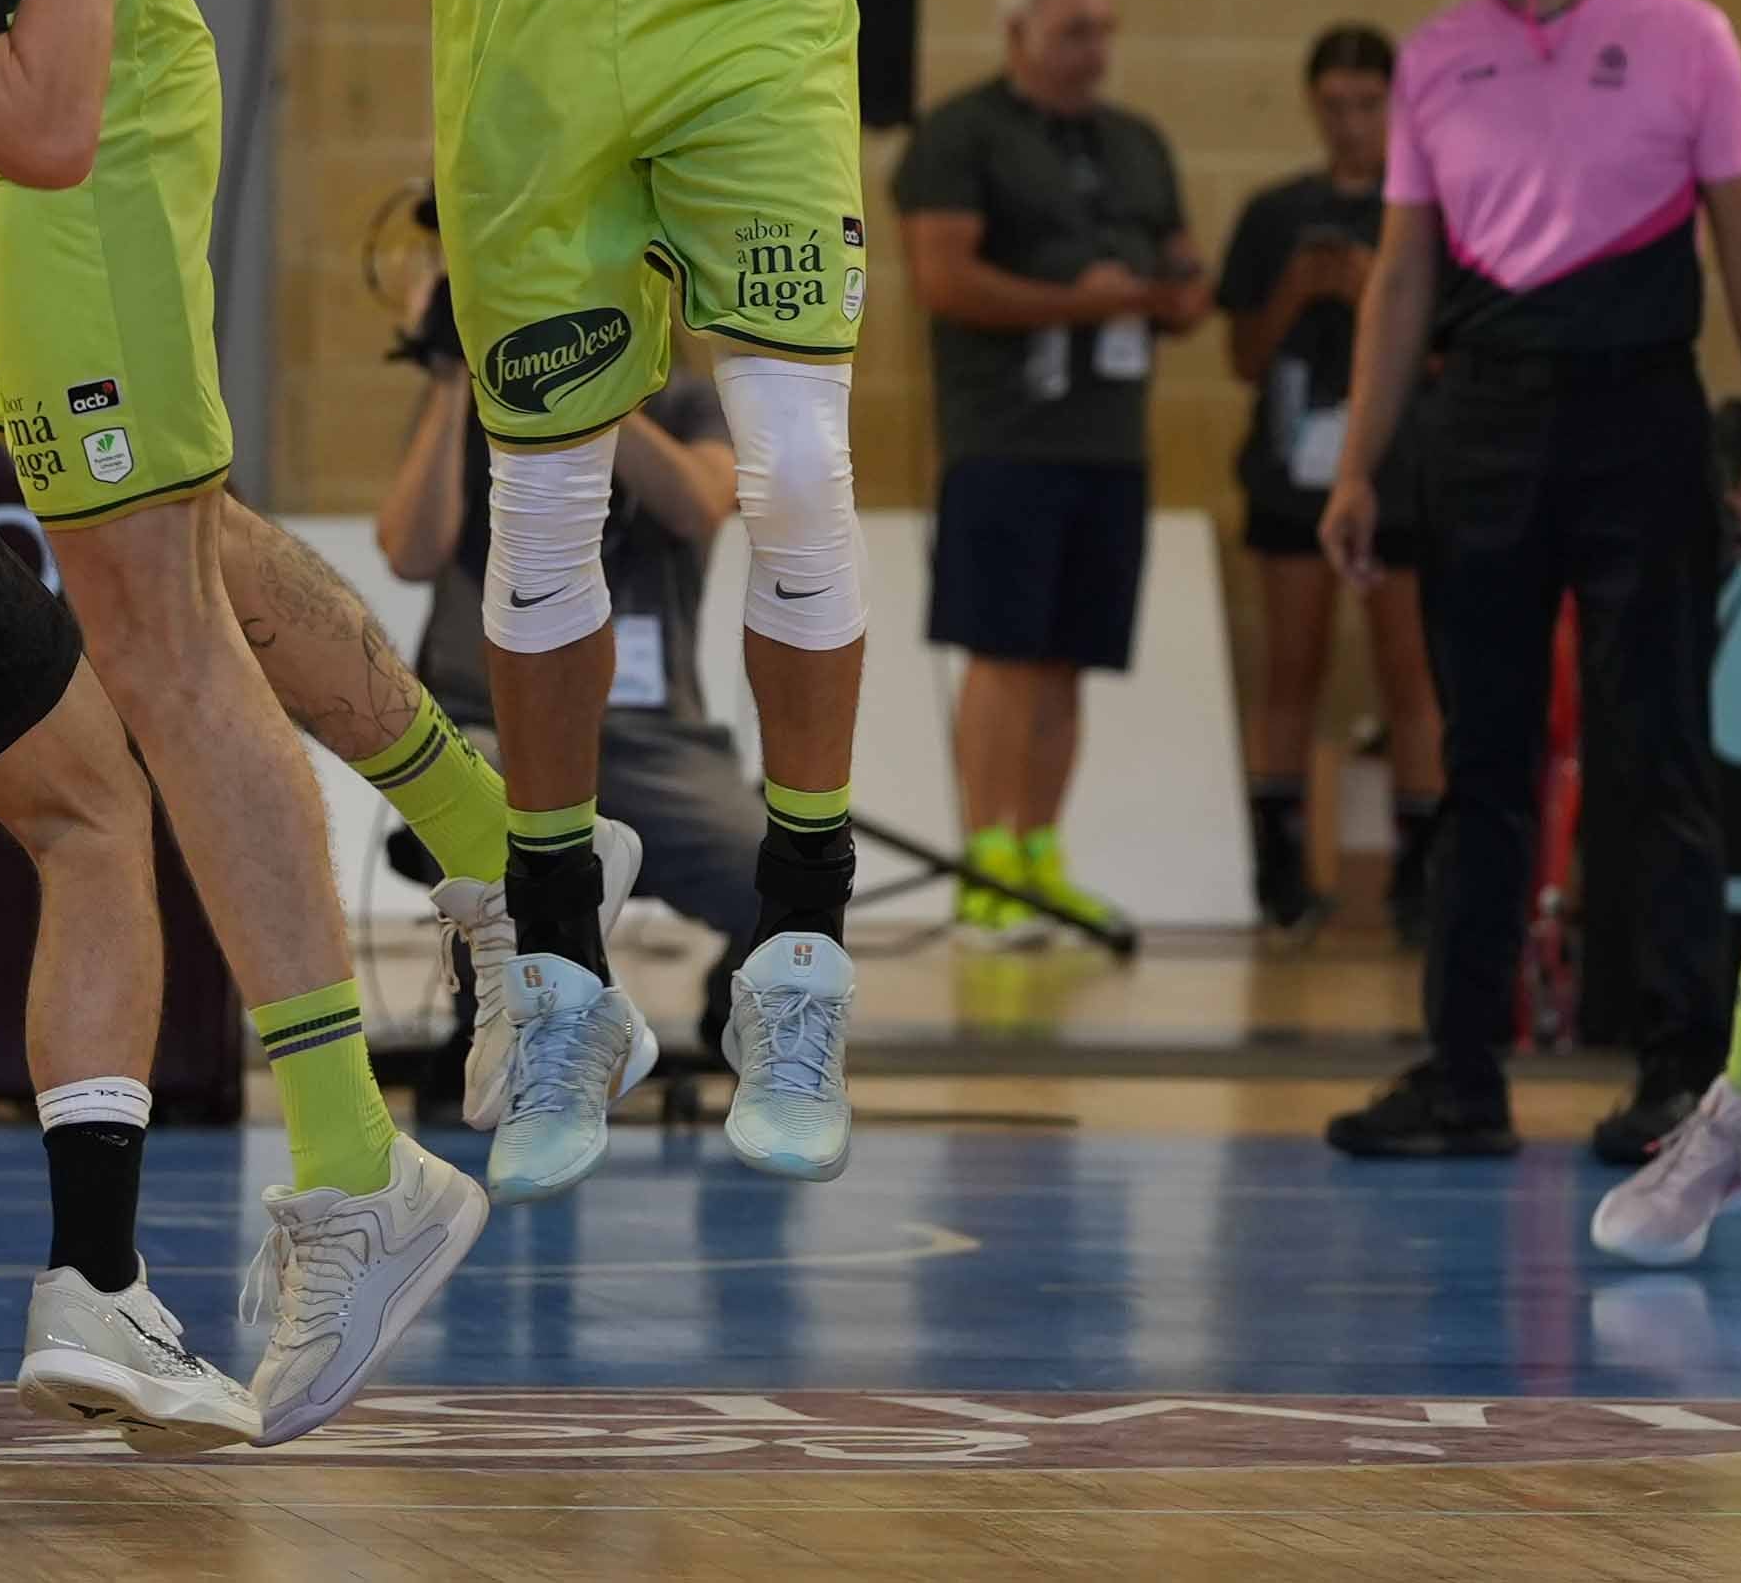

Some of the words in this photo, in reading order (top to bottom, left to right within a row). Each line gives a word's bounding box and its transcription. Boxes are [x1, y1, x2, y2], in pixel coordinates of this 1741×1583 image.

[735, 218, 794, 242] sabor
[737, 248, 748, 264] a
[750, 229, 826, 275] má
[736, 271, 828, 321] laga
[494, 316, 627, 393] famadesa
[73, 391, 108, 412] acb
[15, 448, 66, 491] aga
